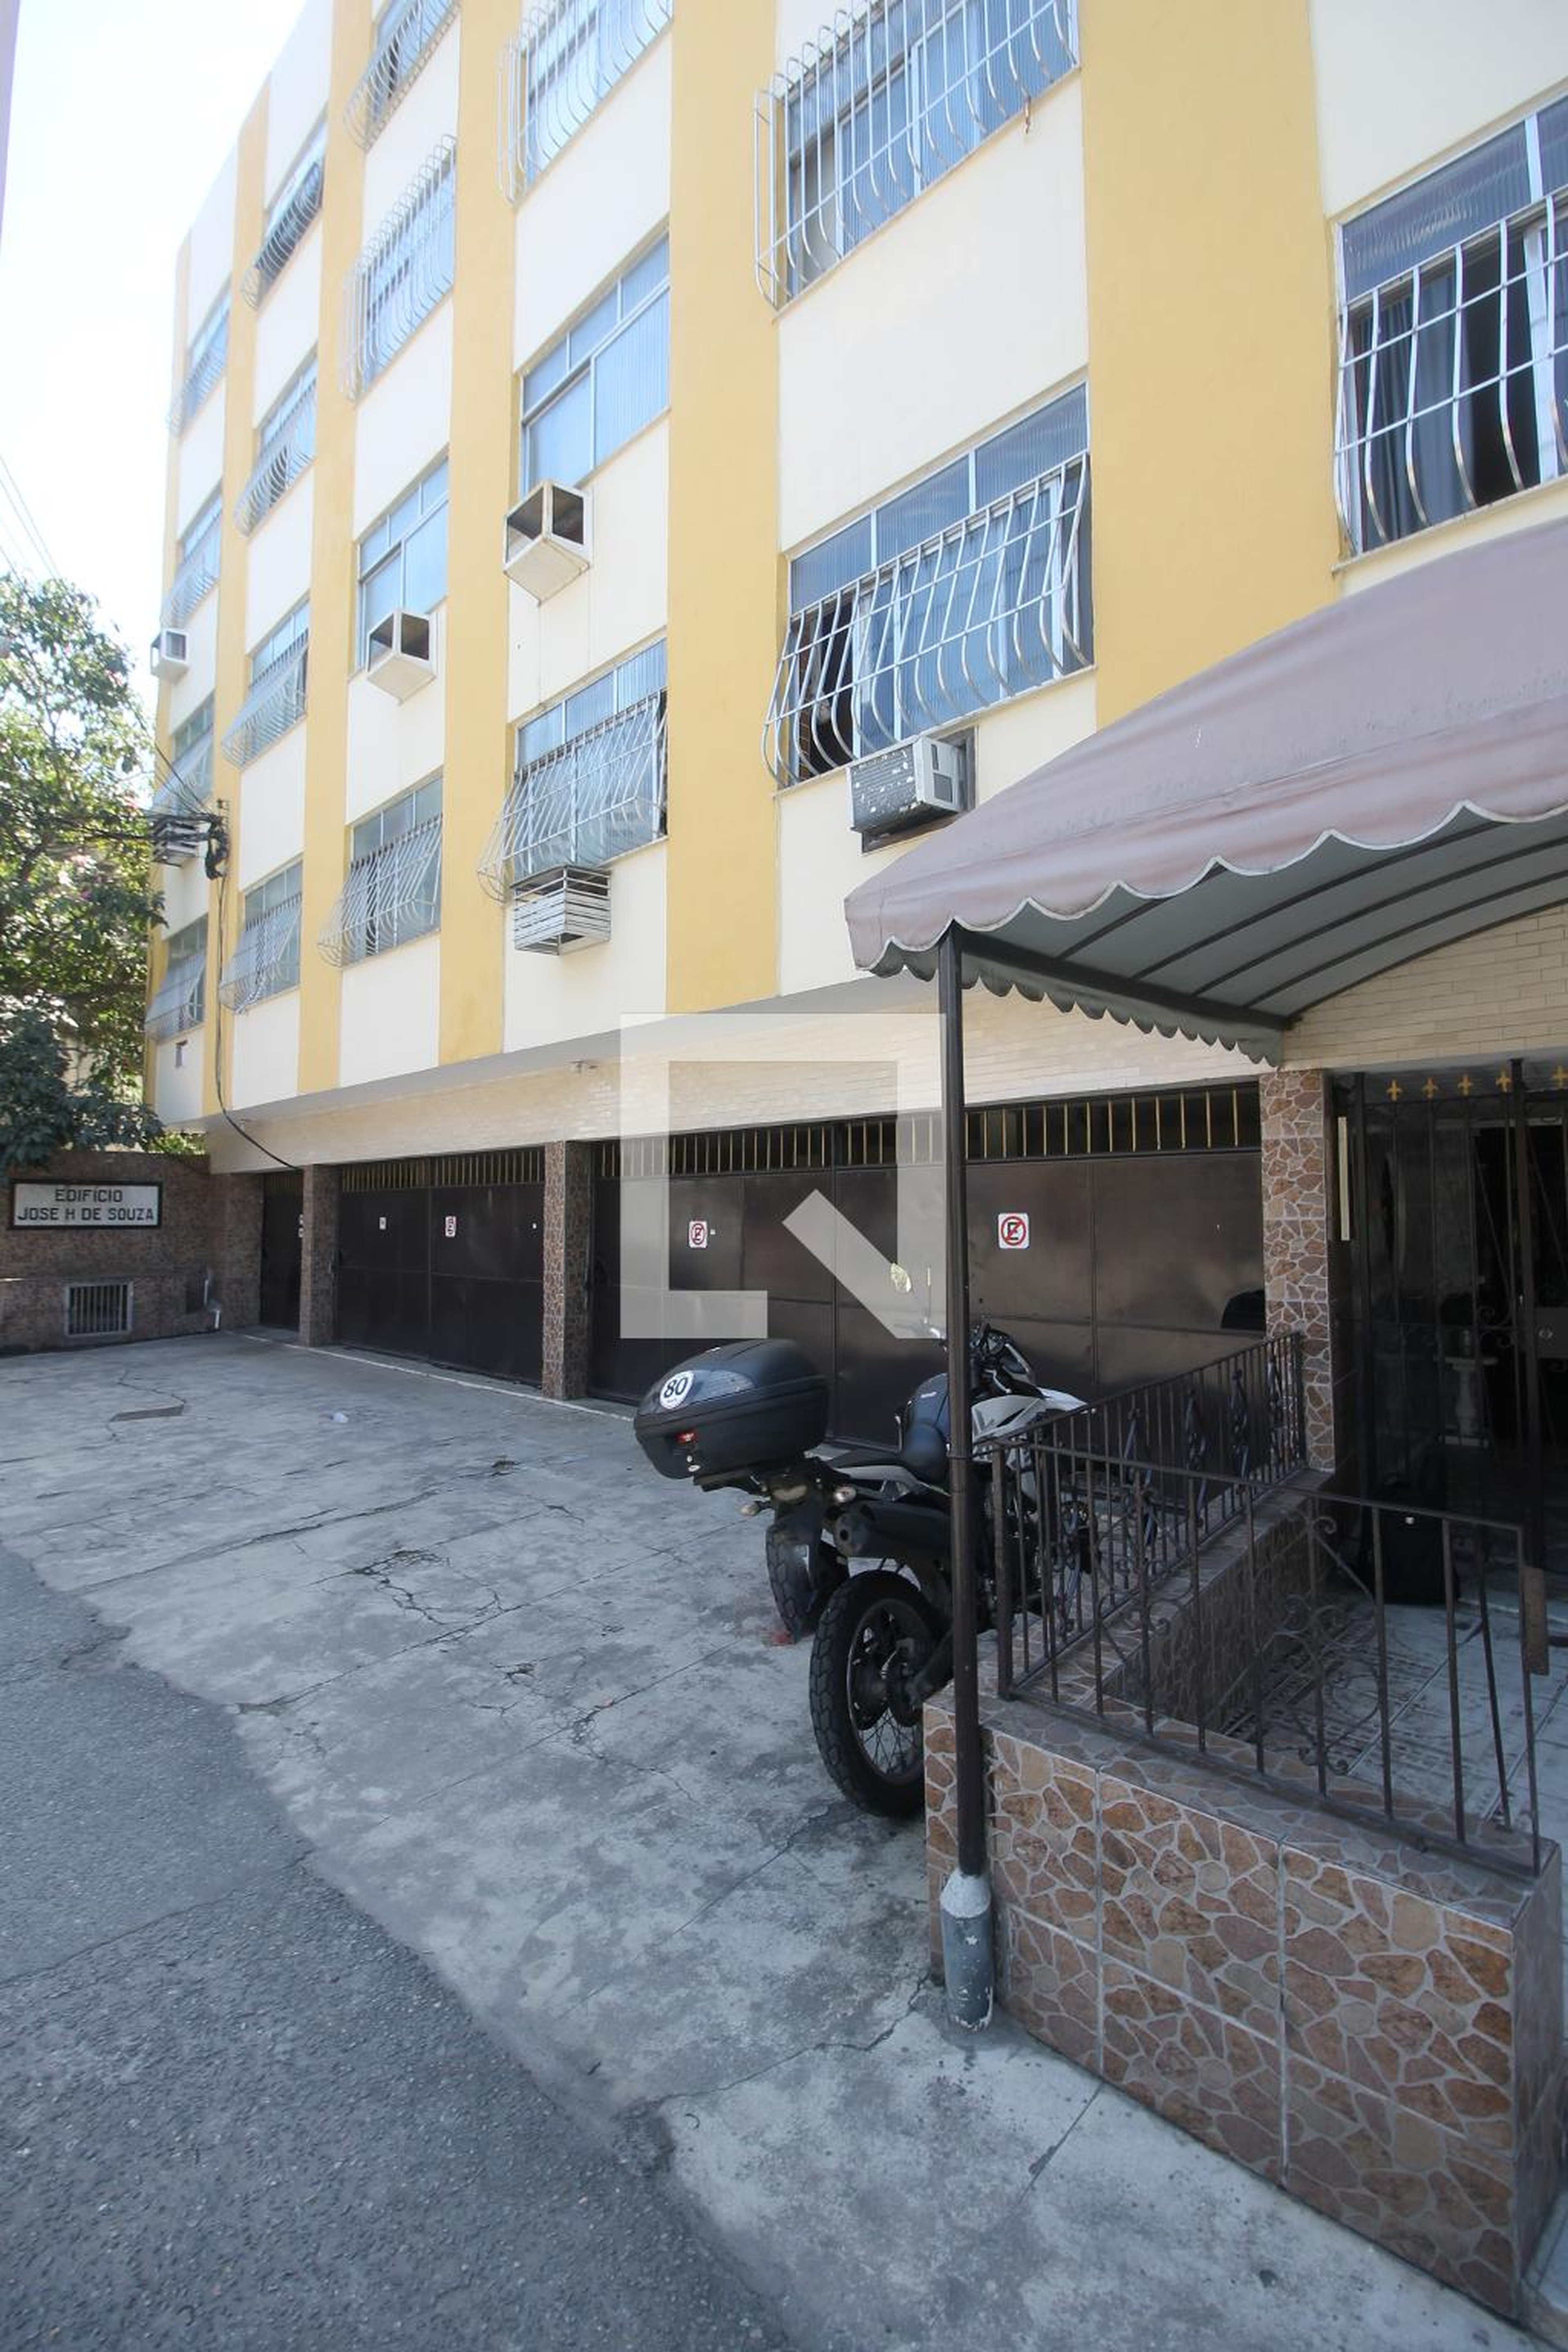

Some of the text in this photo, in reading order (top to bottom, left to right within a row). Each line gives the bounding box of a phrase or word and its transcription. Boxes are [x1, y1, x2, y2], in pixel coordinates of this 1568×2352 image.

[18, 1207, 154, 1221] JOSE H DE SOUZA
[664, 1377, 688, 1398] 80
